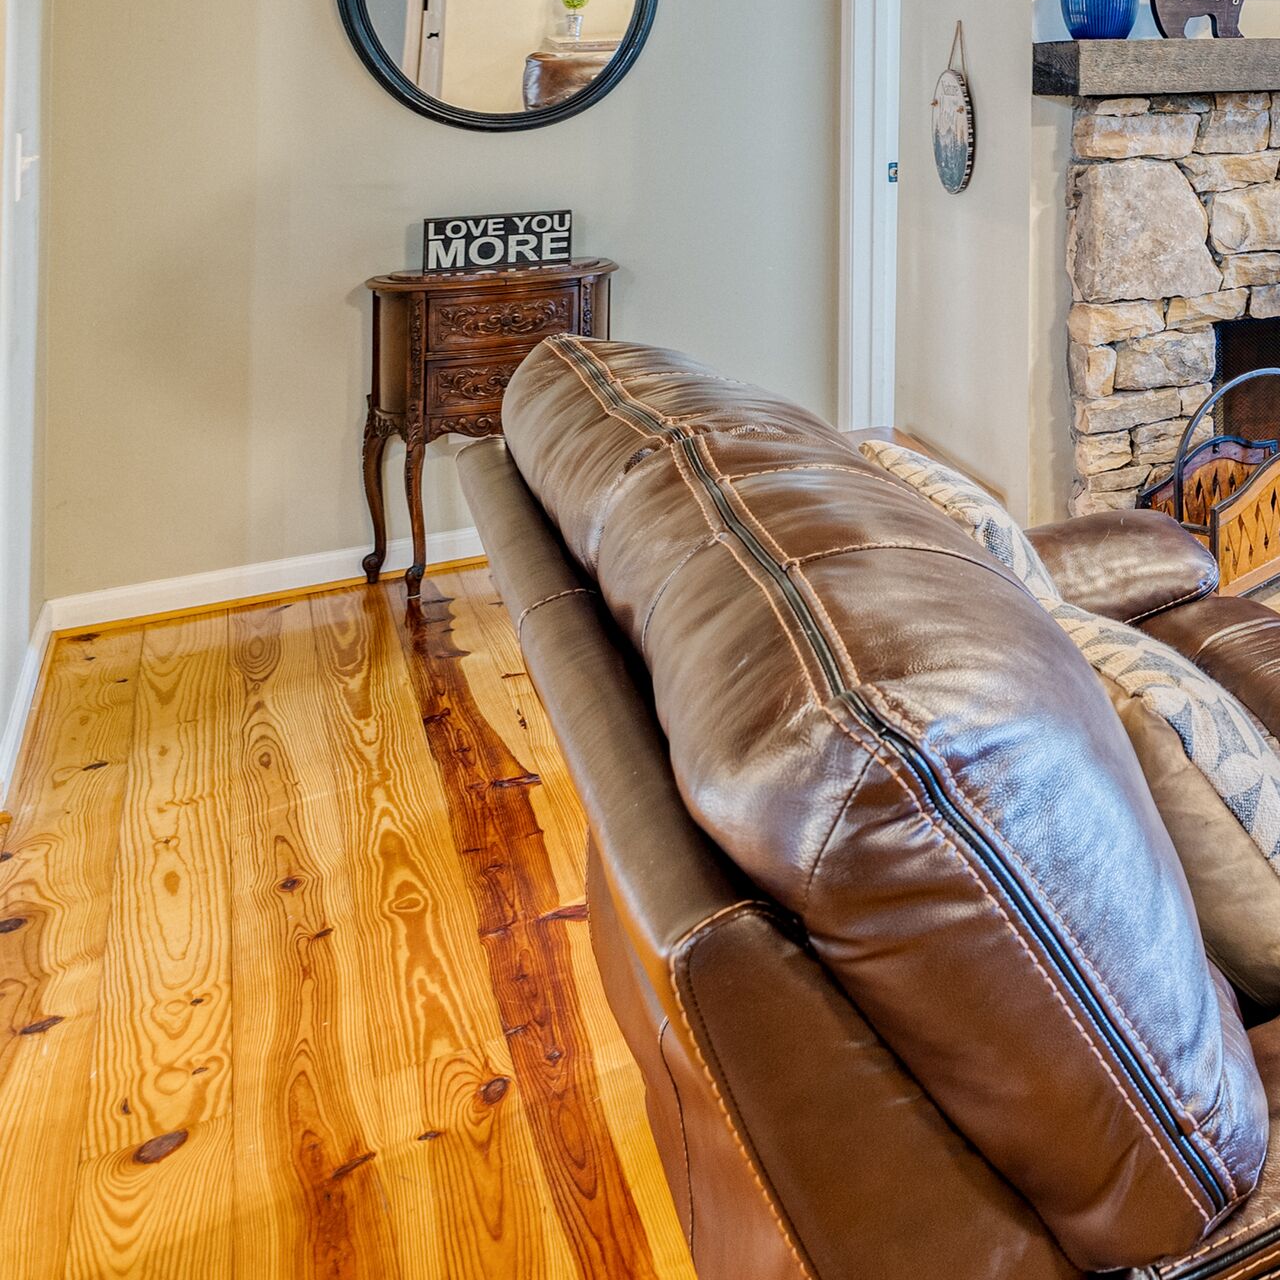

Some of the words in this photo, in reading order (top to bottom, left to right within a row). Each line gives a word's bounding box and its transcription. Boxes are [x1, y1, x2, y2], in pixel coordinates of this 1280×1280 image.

[428, 218, 505, 240] LOVE
[512, 213, 571, 234] YOU
[428, 231, 570, 270] MORE
